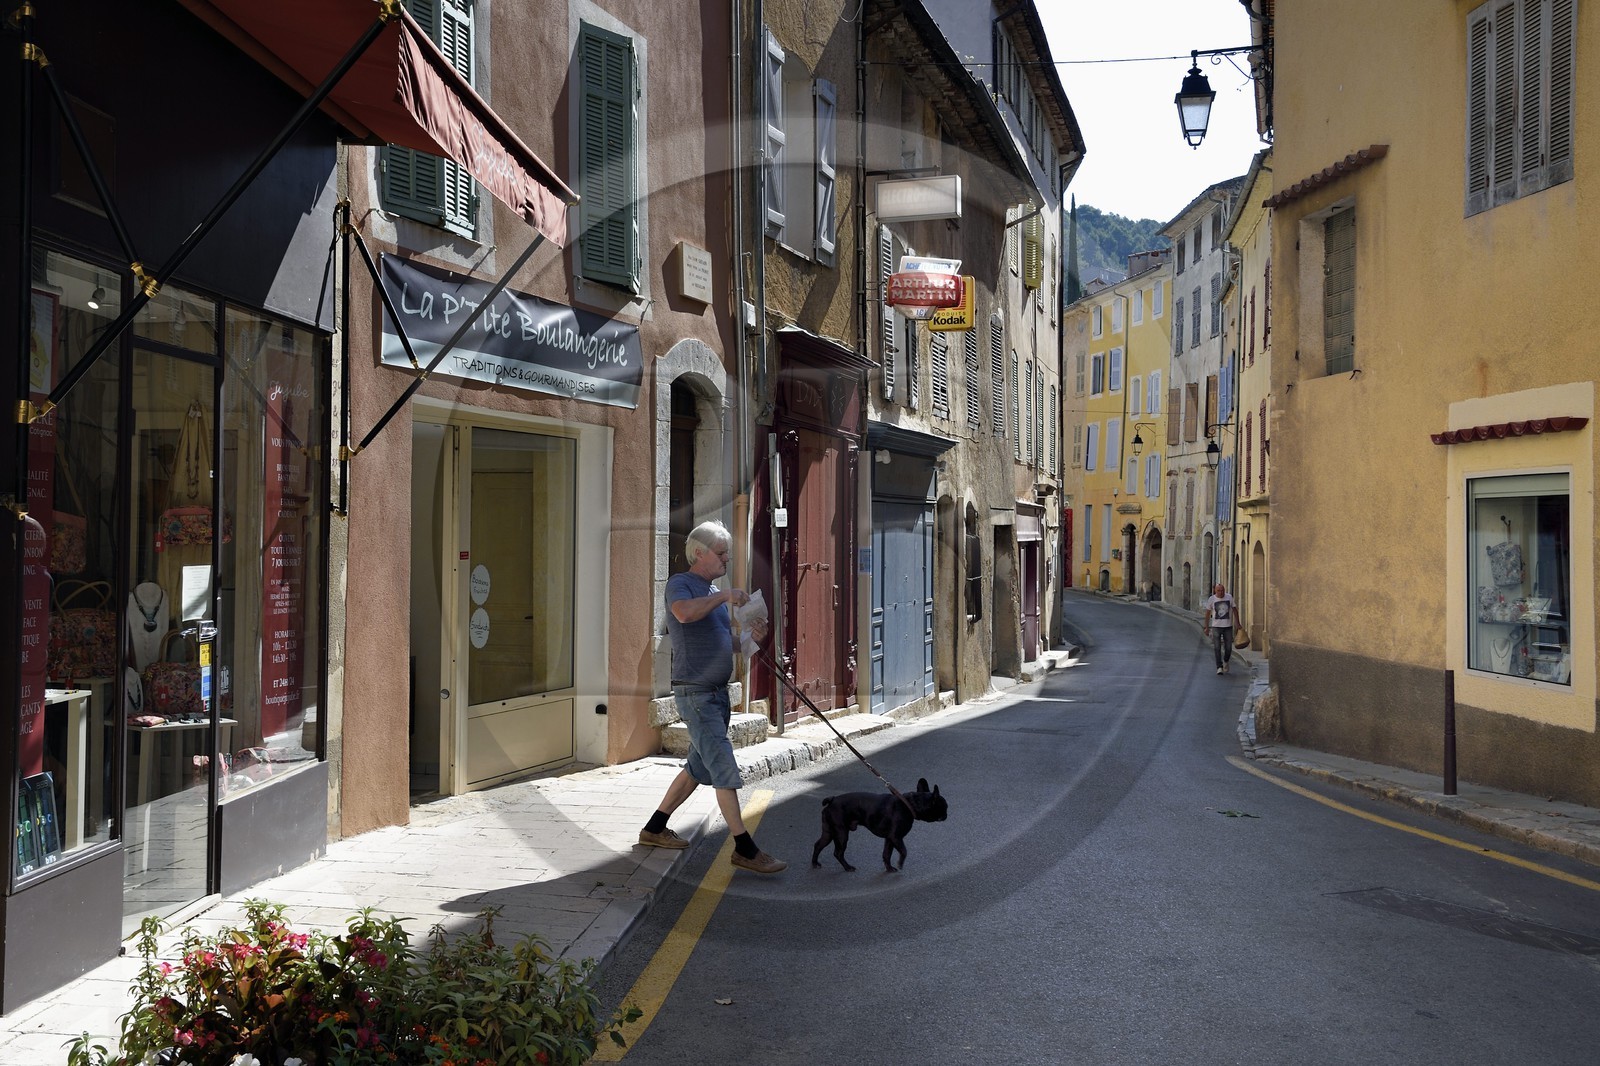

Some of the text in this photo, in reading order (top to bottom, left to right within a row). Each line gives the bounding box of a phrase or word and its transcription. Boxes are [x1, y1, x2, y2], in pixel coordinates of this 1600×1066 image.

[891, 289, 956, 301] MARTIN
[401, 282, 434, 320] La
[516, 311, 628, 370] Boulangerie
[933, 315, 966, 326] Kodak
[270, 380, 310, 402] Jujube
[271, 558, 276, 567] 7
[276, 558, 289, 568] JOURS
[24, 599, 43, 611] VENTE
[23, 617, 37, 628] FACE
[274, 629, 296, 639] HORAIRES
[273, 679, 279, 688] ET
[21, 685, 31, 699] LES
